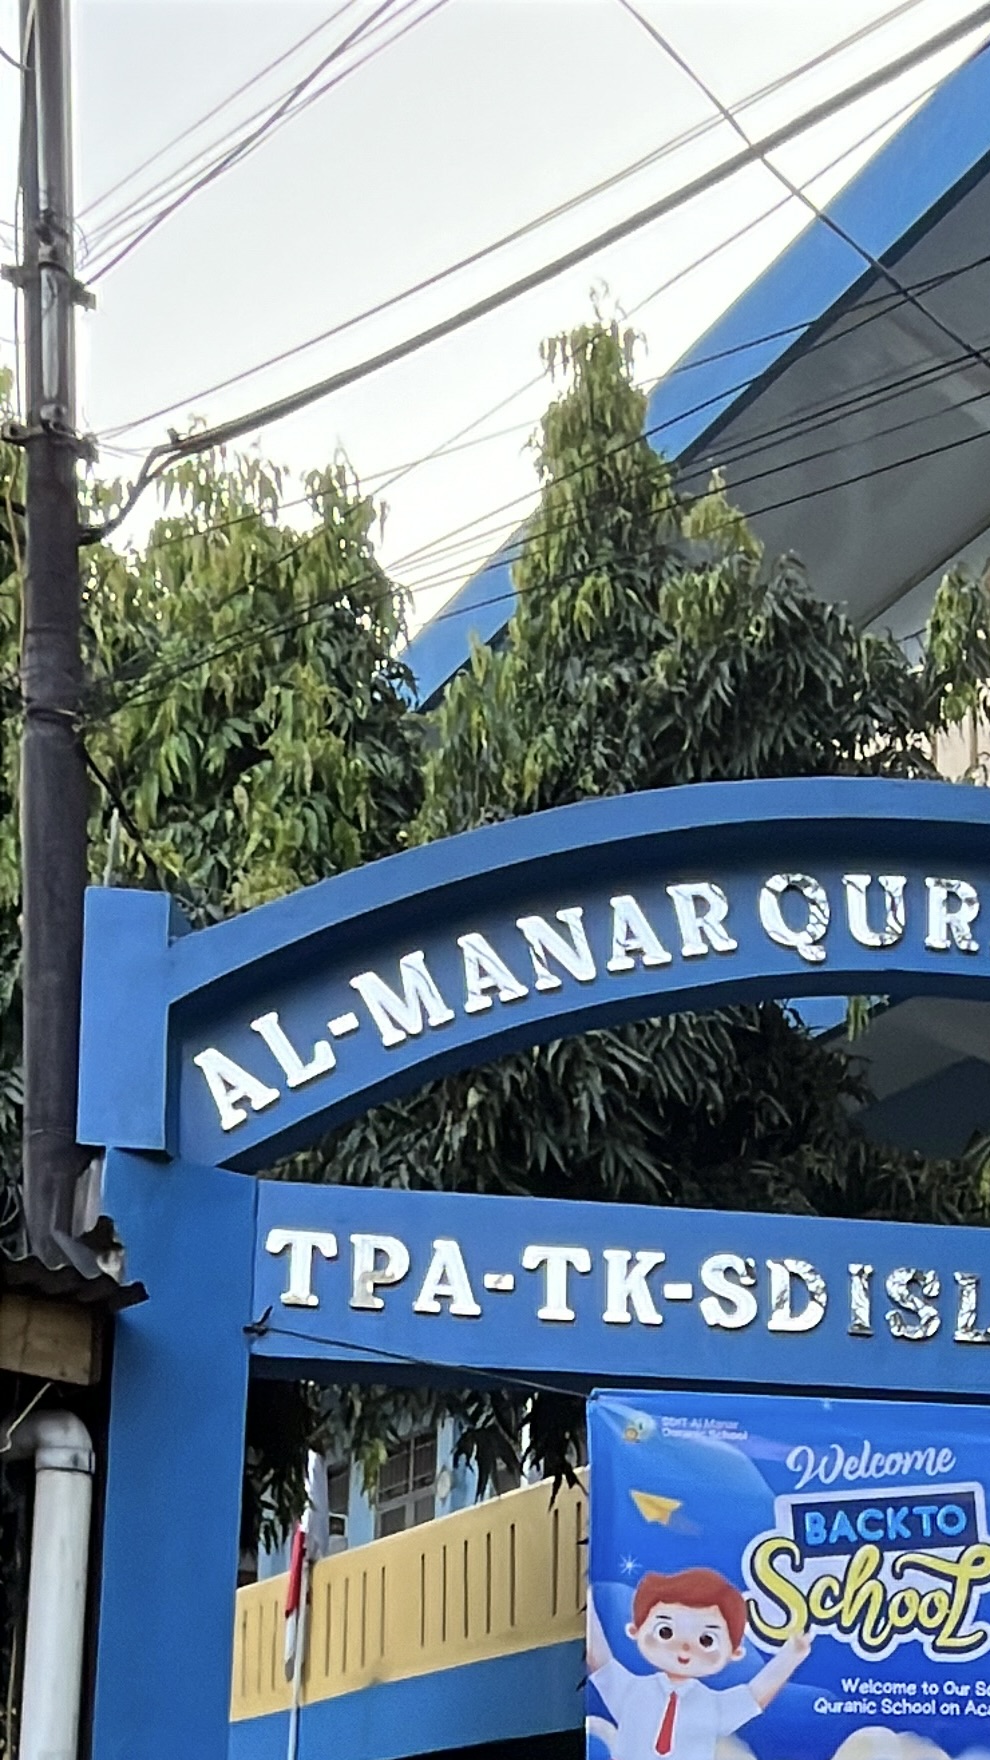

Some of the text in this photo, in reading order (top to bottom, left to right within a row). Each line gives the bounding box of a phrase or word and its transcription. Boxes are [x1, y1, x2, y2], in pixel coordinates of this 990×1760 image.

[193, 882, 738, 1132] AL-MANAR
[786, 1440, 956, 1490] Welcome
[841, 1677, 917, 1696] Welcome
[921, 1681, 939, 1696] to
[943, 1680, 970, 1697] Our
[813, 1697, 877, 1715] Quranic
[881, 1698, 936, 1715] School
[939, 1702, 960, 1716] on
